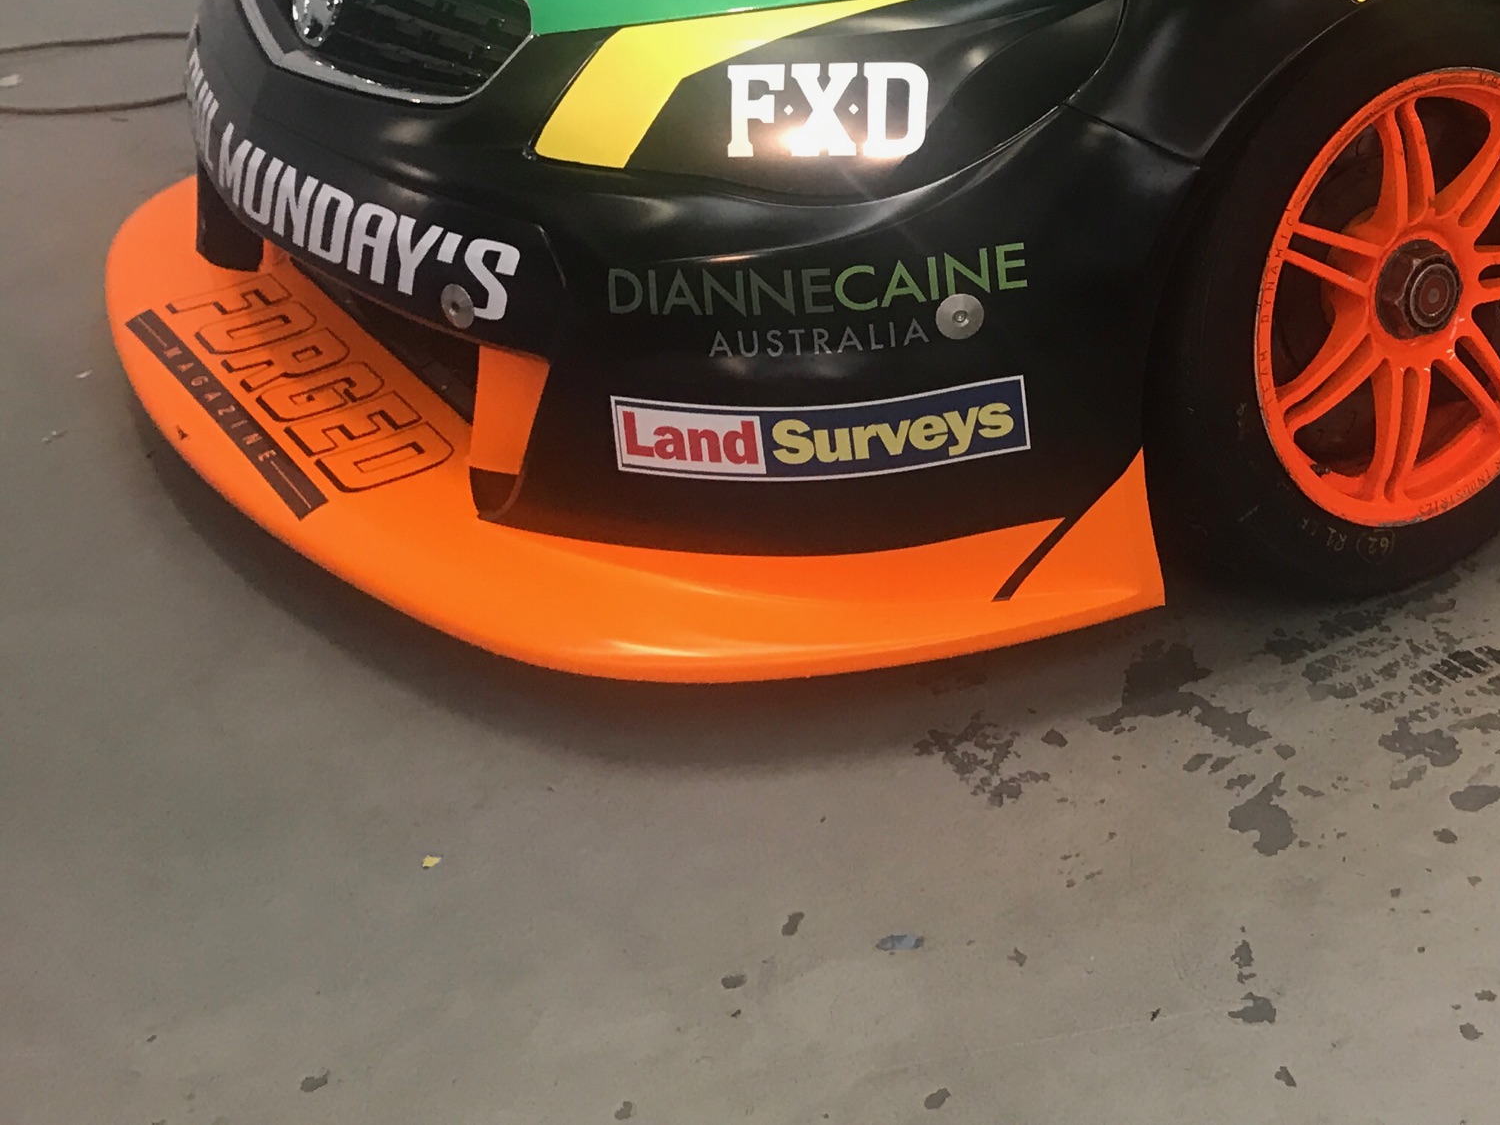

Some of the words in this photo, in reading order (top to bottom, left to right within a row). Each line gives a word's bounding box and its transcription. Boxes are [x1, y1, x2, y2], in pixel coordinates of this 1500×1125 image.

[218, 121, 521, 321] MUNDAY'S
[607, 241, 1029, 317] DIANNECAINE
[708, 317, 930, 358] AUSTRALIA
[162, 344, 278, 464] MAGAZINE
[620, 410, 760, 465] Land
[771, 402, 1014, 465] Surveys
